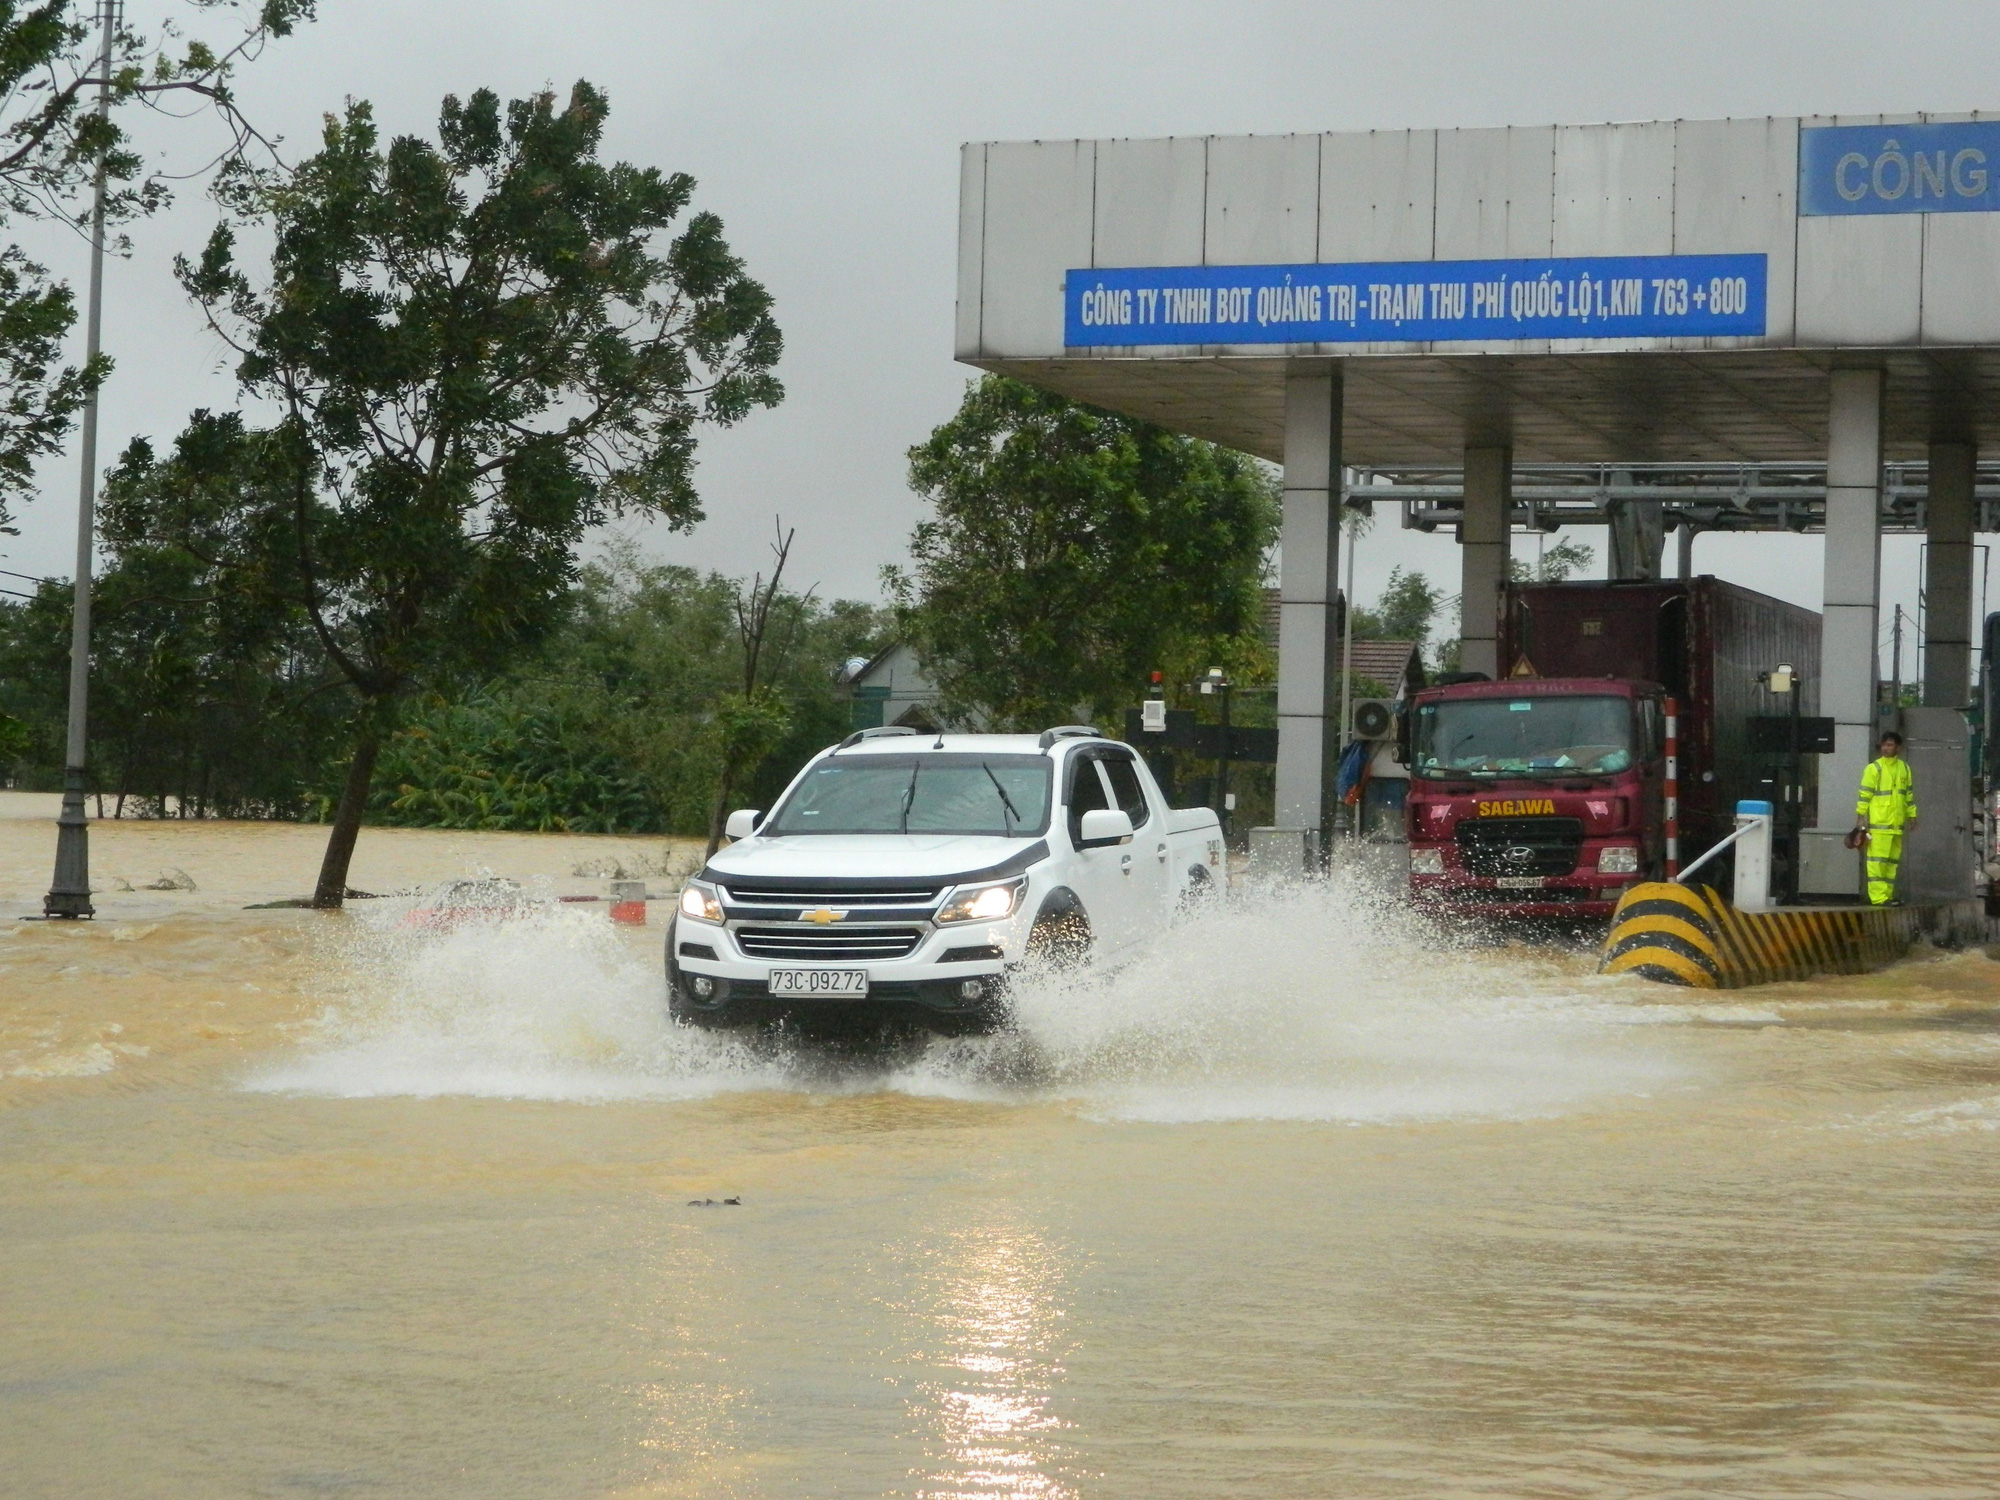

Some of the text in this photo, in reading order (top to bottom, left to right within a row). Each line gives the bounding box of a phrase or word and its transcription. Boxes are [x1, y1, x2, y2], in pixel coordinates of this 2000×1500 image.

[1835, 138, 1987, 201] CÔNG
[1081, 282, 1132, 326] CÔNG
[1136, 288, 1159, 325] TY
[1162, 288, 1212, 325] TNHH
[1216, 287, 1252, 324] BOT
[1256, 273, 1322, 327] QUẢNG
[1429, 283, 1466, 320] THU
[1472, 274, 1507, 319] PHÍ
[1510, 270, 1563, 322] QUỐC
[1479, 799, 1555, 816] SAGAWA
[773, 971, 864, 991] 73C-092.72
